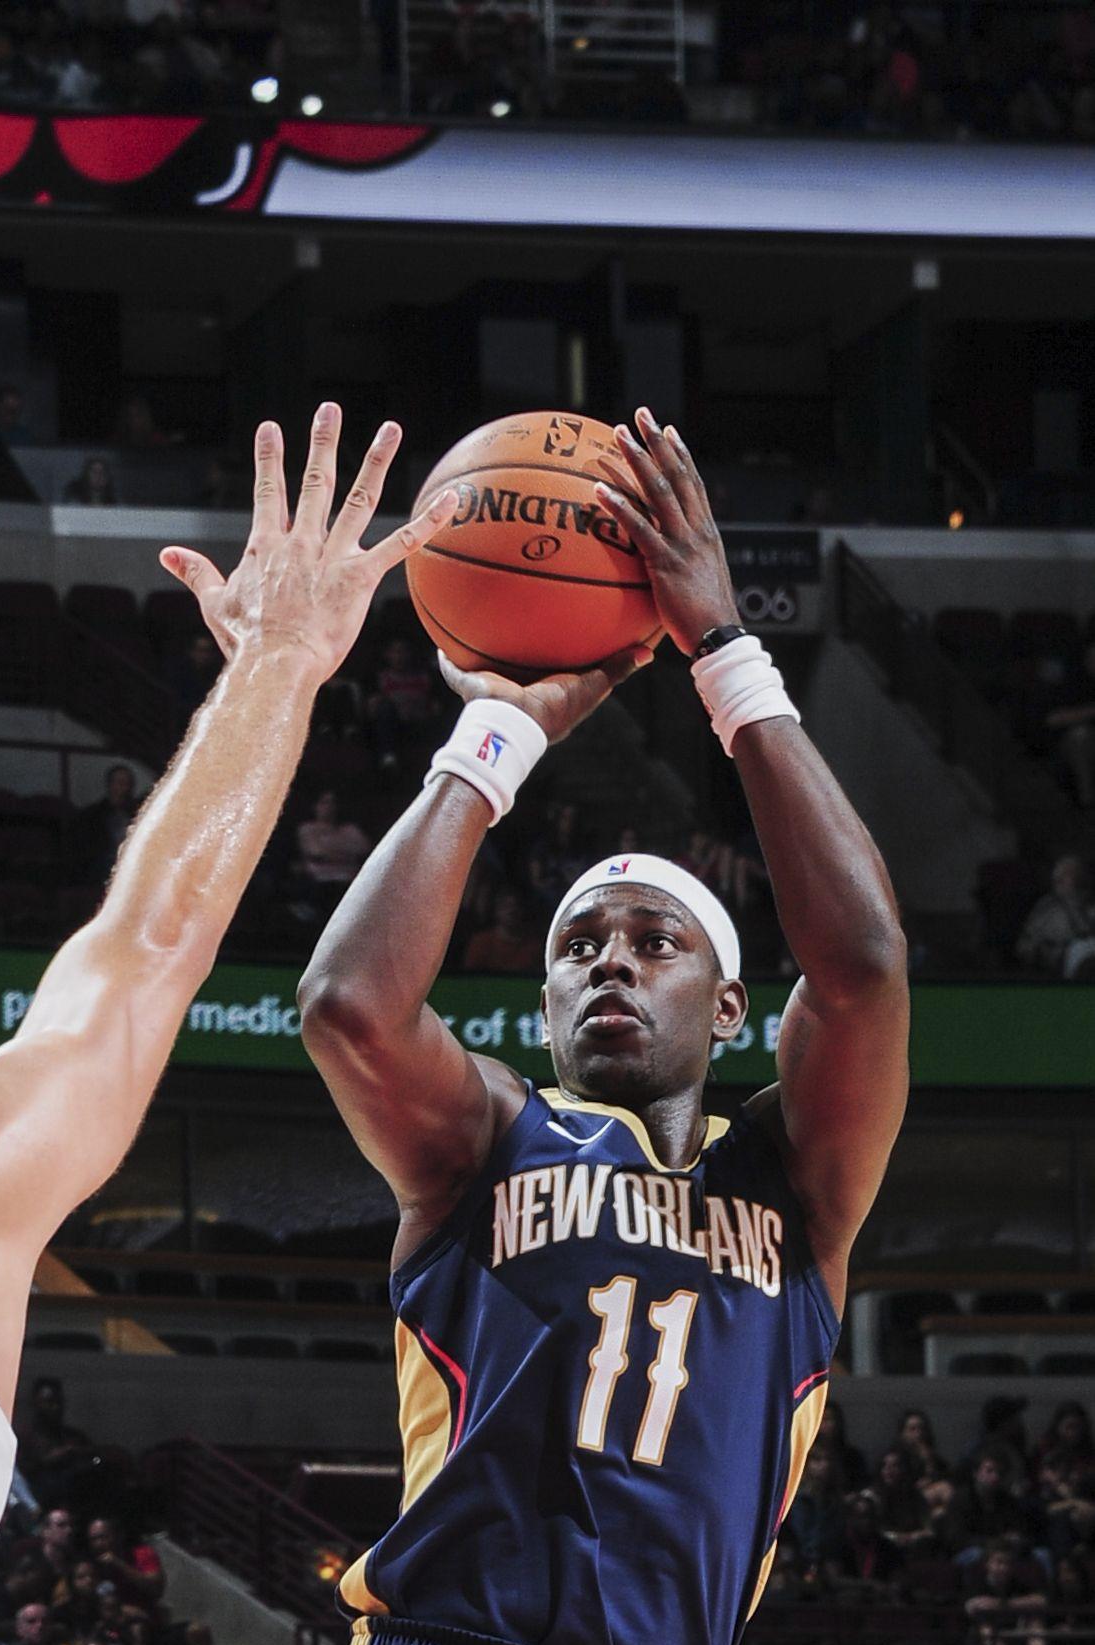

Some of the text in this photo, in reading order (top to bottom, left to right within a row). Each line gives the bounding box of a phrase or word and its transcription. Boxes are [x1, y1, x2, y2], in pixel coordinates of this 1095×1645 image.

[451, 482, 638, 556] PALDING
[737, 586, 797, 622] 06
[189, 995, 302, 1036] medic
[463, 1008, 505, 1048] of
[492, 1163, 784, 1299] NEW ORLANS
[576, 1274, 699, 1467] 11
